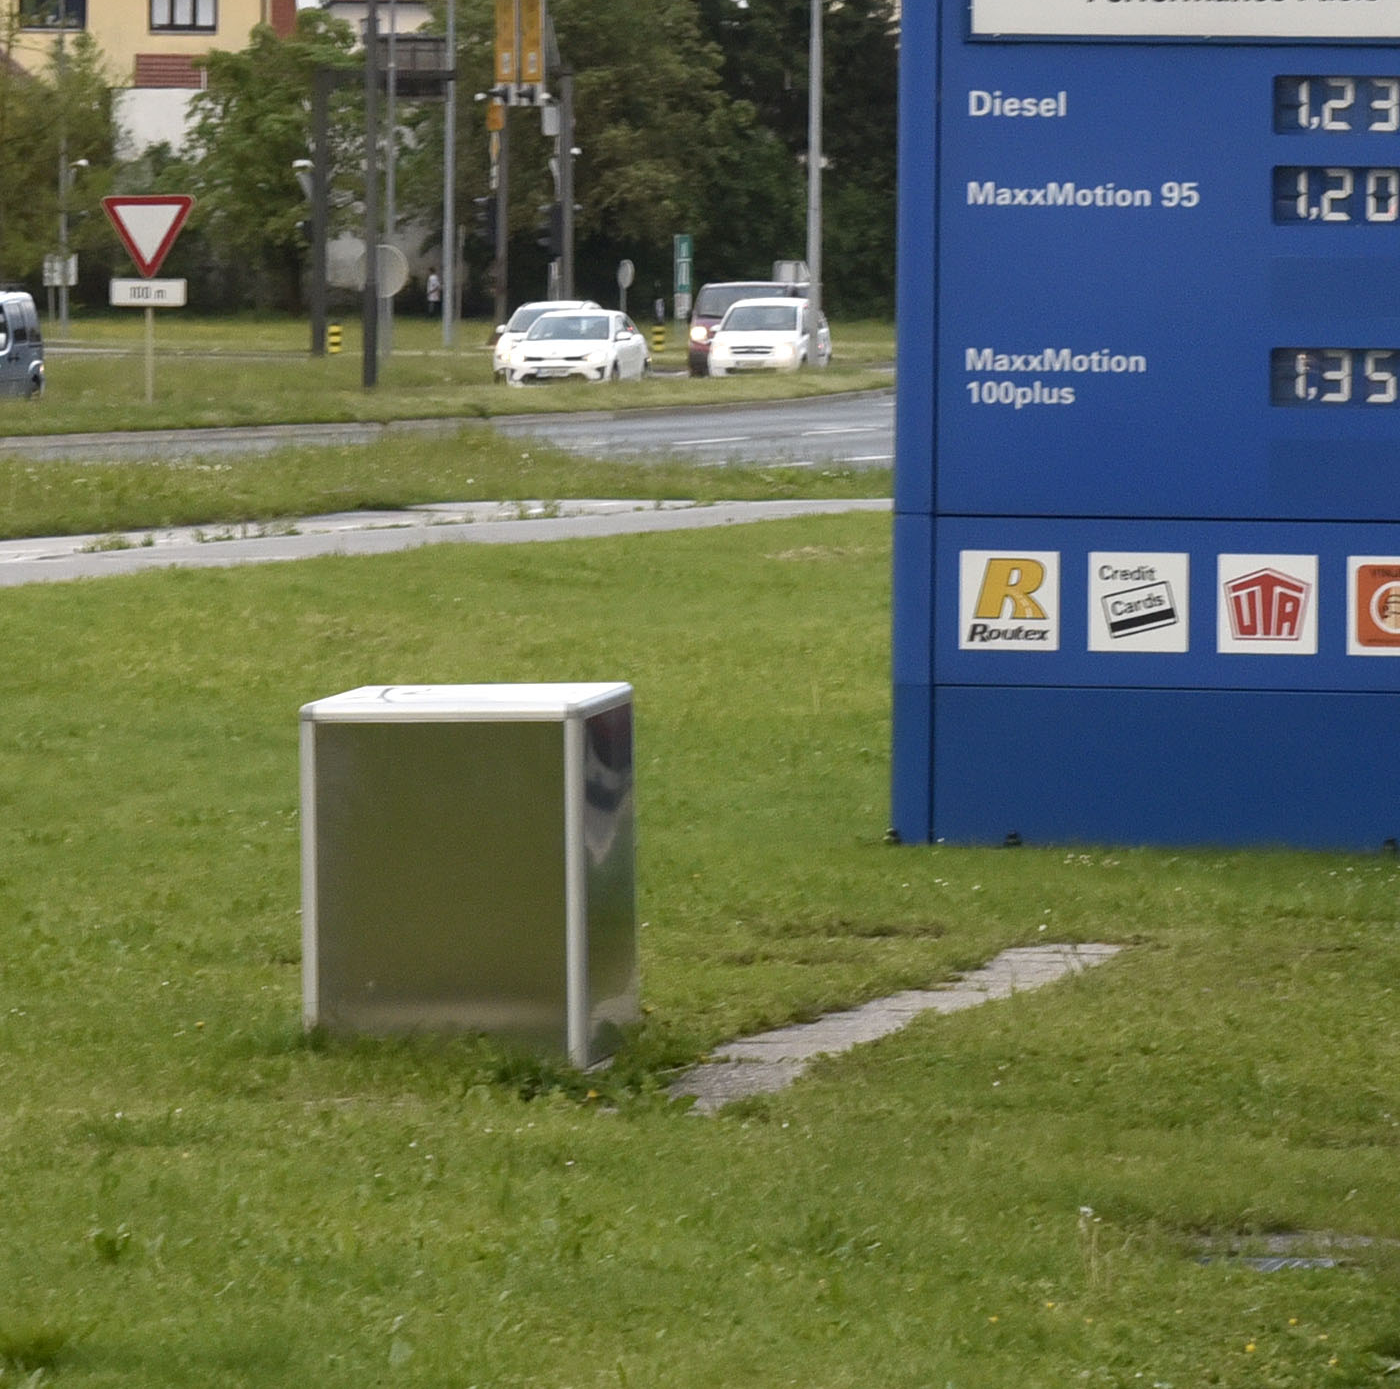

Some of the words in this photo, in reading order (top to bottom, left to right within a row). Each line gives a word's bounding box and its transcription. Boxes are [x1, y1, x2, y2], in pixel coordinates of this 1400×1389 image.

[968, 90, 1068, 117] Diesel
[966, 181, 1153, 207] MaxxMotion
[1161, 182, 1201, 208] 95
[964, 348, 1148, 373] MaxxMotion
[966, 381, 1076, 410] 100plus
[1098, 564, 1156, 582] Credit
[1111, 592, 1166, 617] Cards
[1231, 573, 1305, 637] UTA
[967, 623, 1049, 643] Routex
